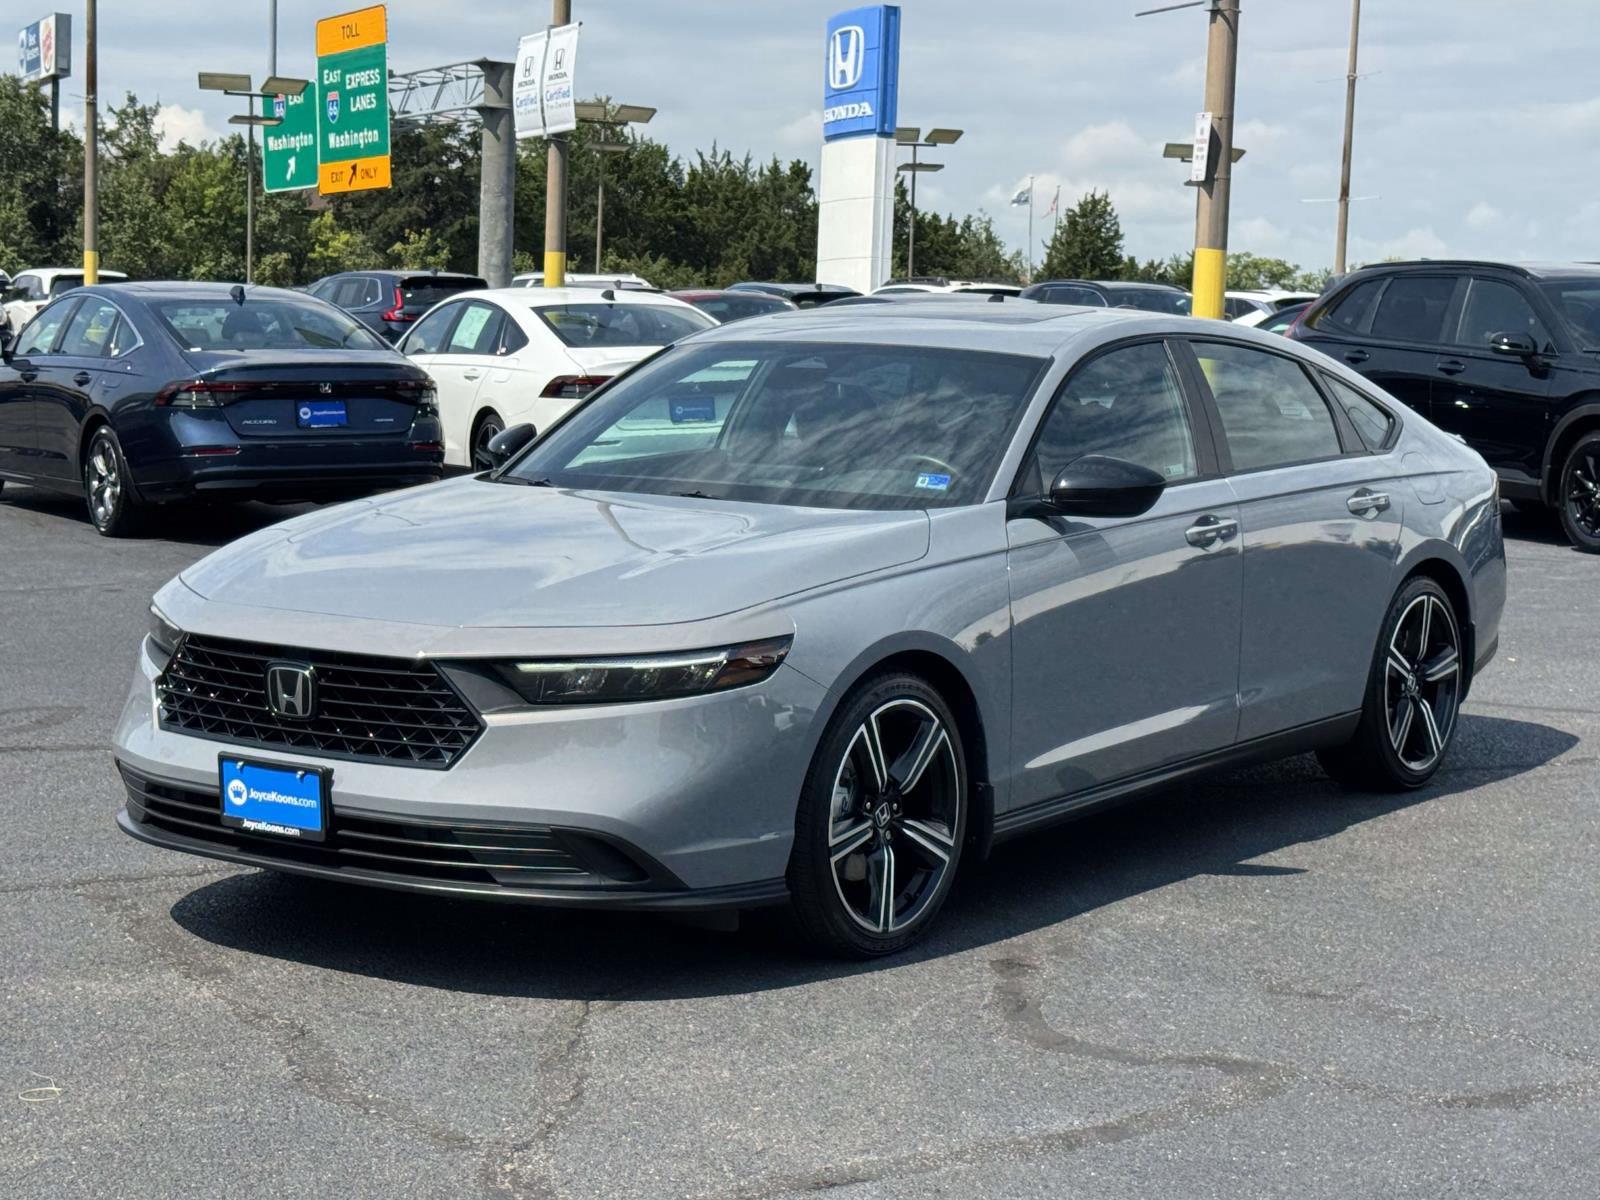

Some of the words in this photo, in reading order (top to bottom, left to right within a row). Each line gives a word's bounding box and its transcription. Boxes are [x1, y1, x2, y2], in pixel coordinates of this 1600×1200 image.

[341, 23, 360, 40] TOLL
[323, 69, 341, 85] EAST
[346, 69, 379, 89] EXPRESS
[328, 101, 338, 115] 66
[350, 93, 376, 111] LANES
[267, 131, 314, 152] Washington
[328, 128, 379, 149] Washington
[330, 171, 344, 183] EXIT
[361, 166, 378, 180] ONLY
[249, 788, 317, 808] JoyceKoons.com
[243, 819, 300, 836] JoyceKoons.com
